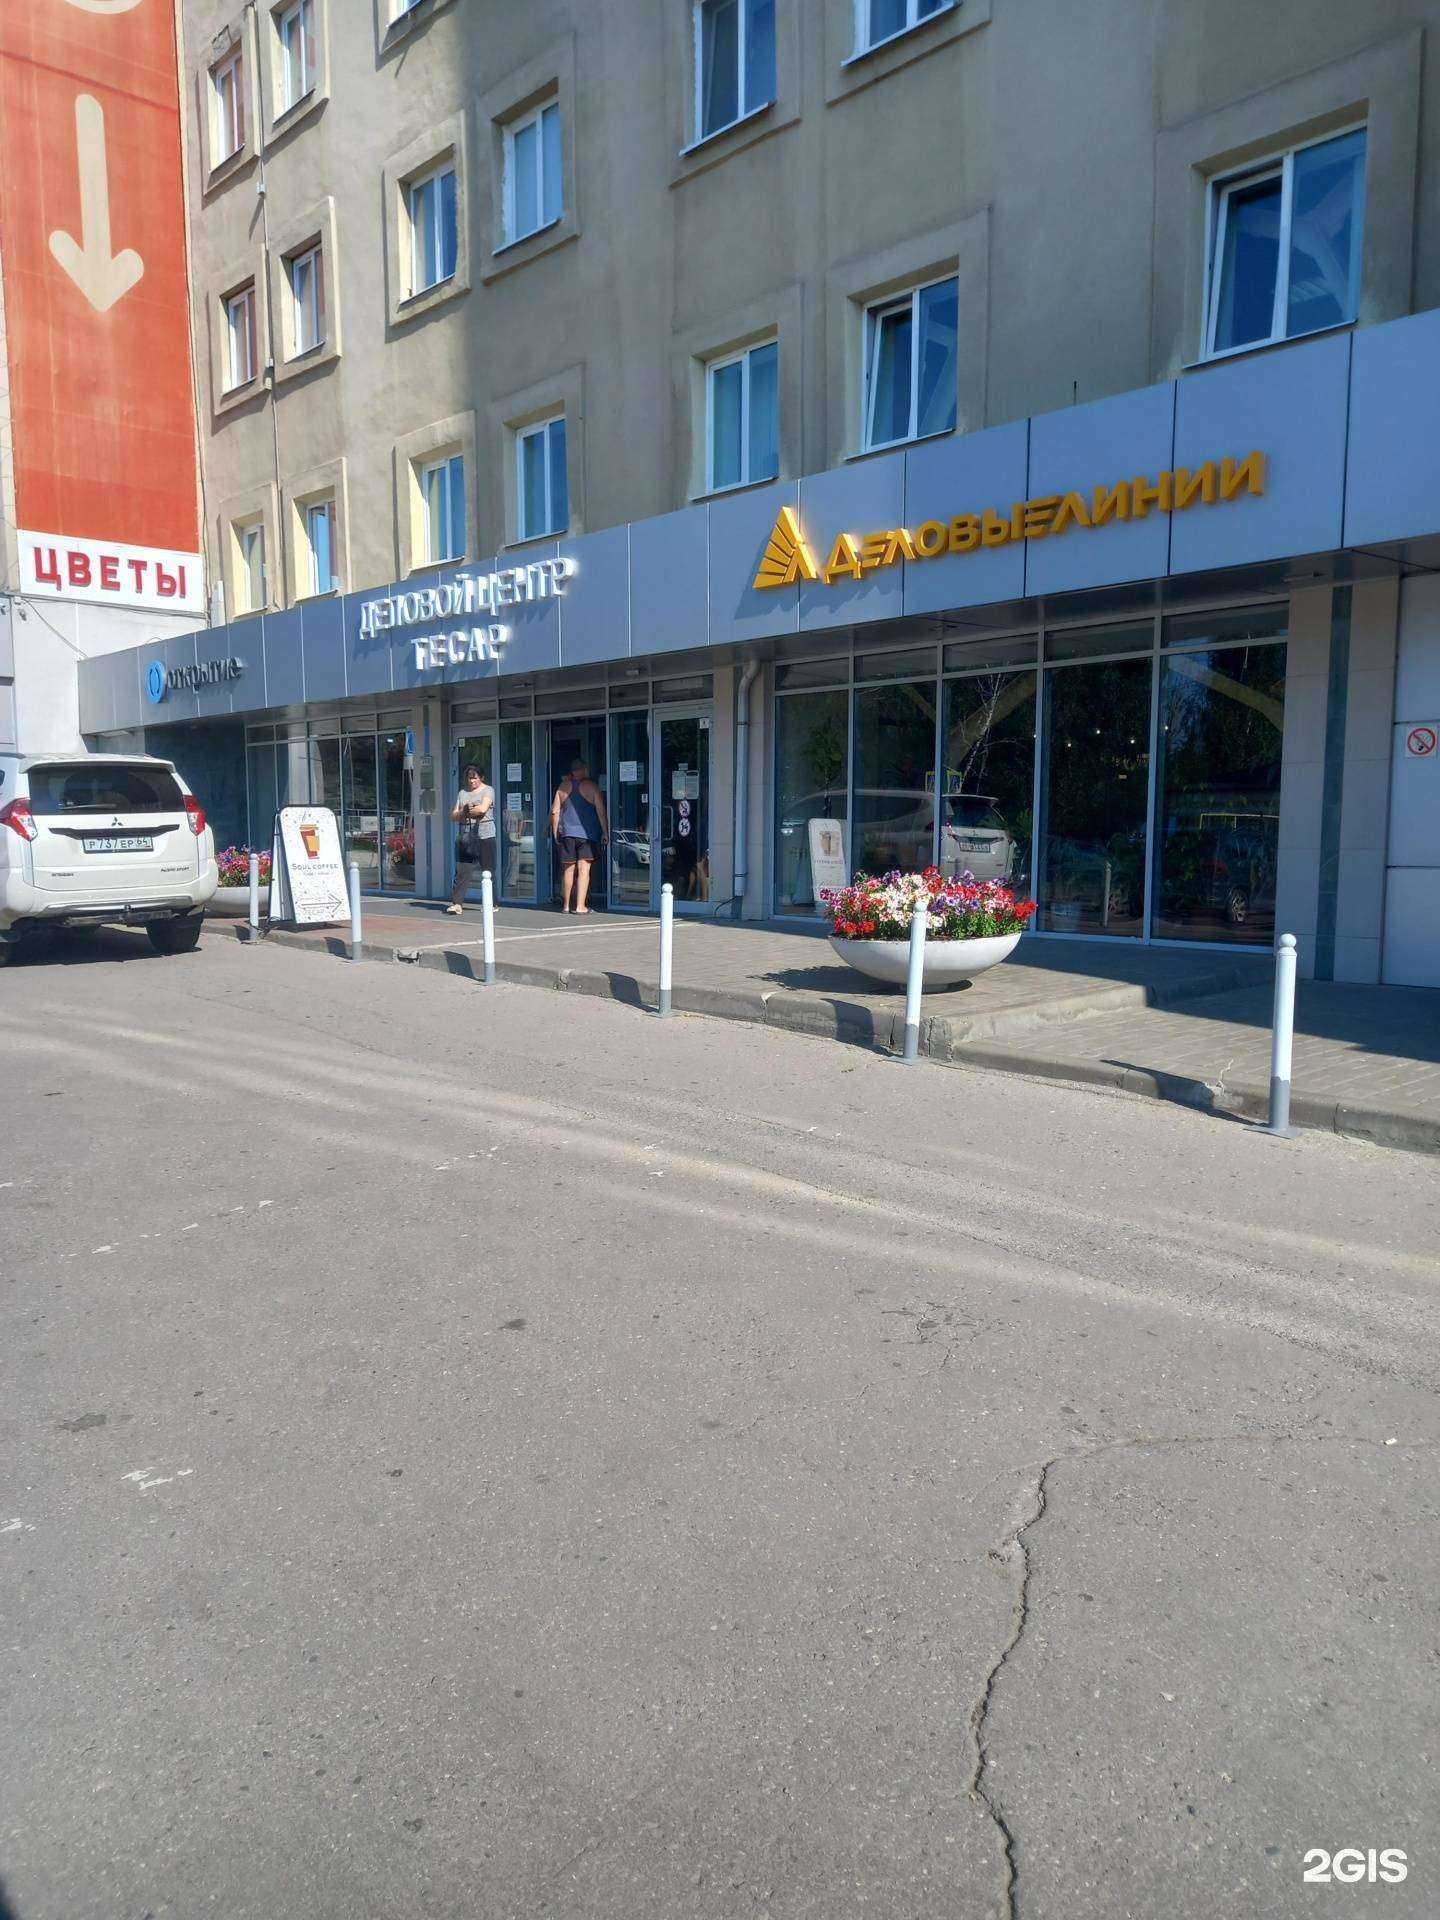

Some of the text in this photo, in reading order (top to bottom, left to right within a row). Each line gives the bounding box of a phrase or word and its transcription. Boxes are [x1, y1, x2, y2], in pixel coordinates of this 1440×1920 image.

[33, 547, 187, 598] ЦВЕТЫ
[359, 557, 575, 640] ДЕЛОВОЙ ЦЕНТР
[411, 624, 508, 670] ТЕСАР
